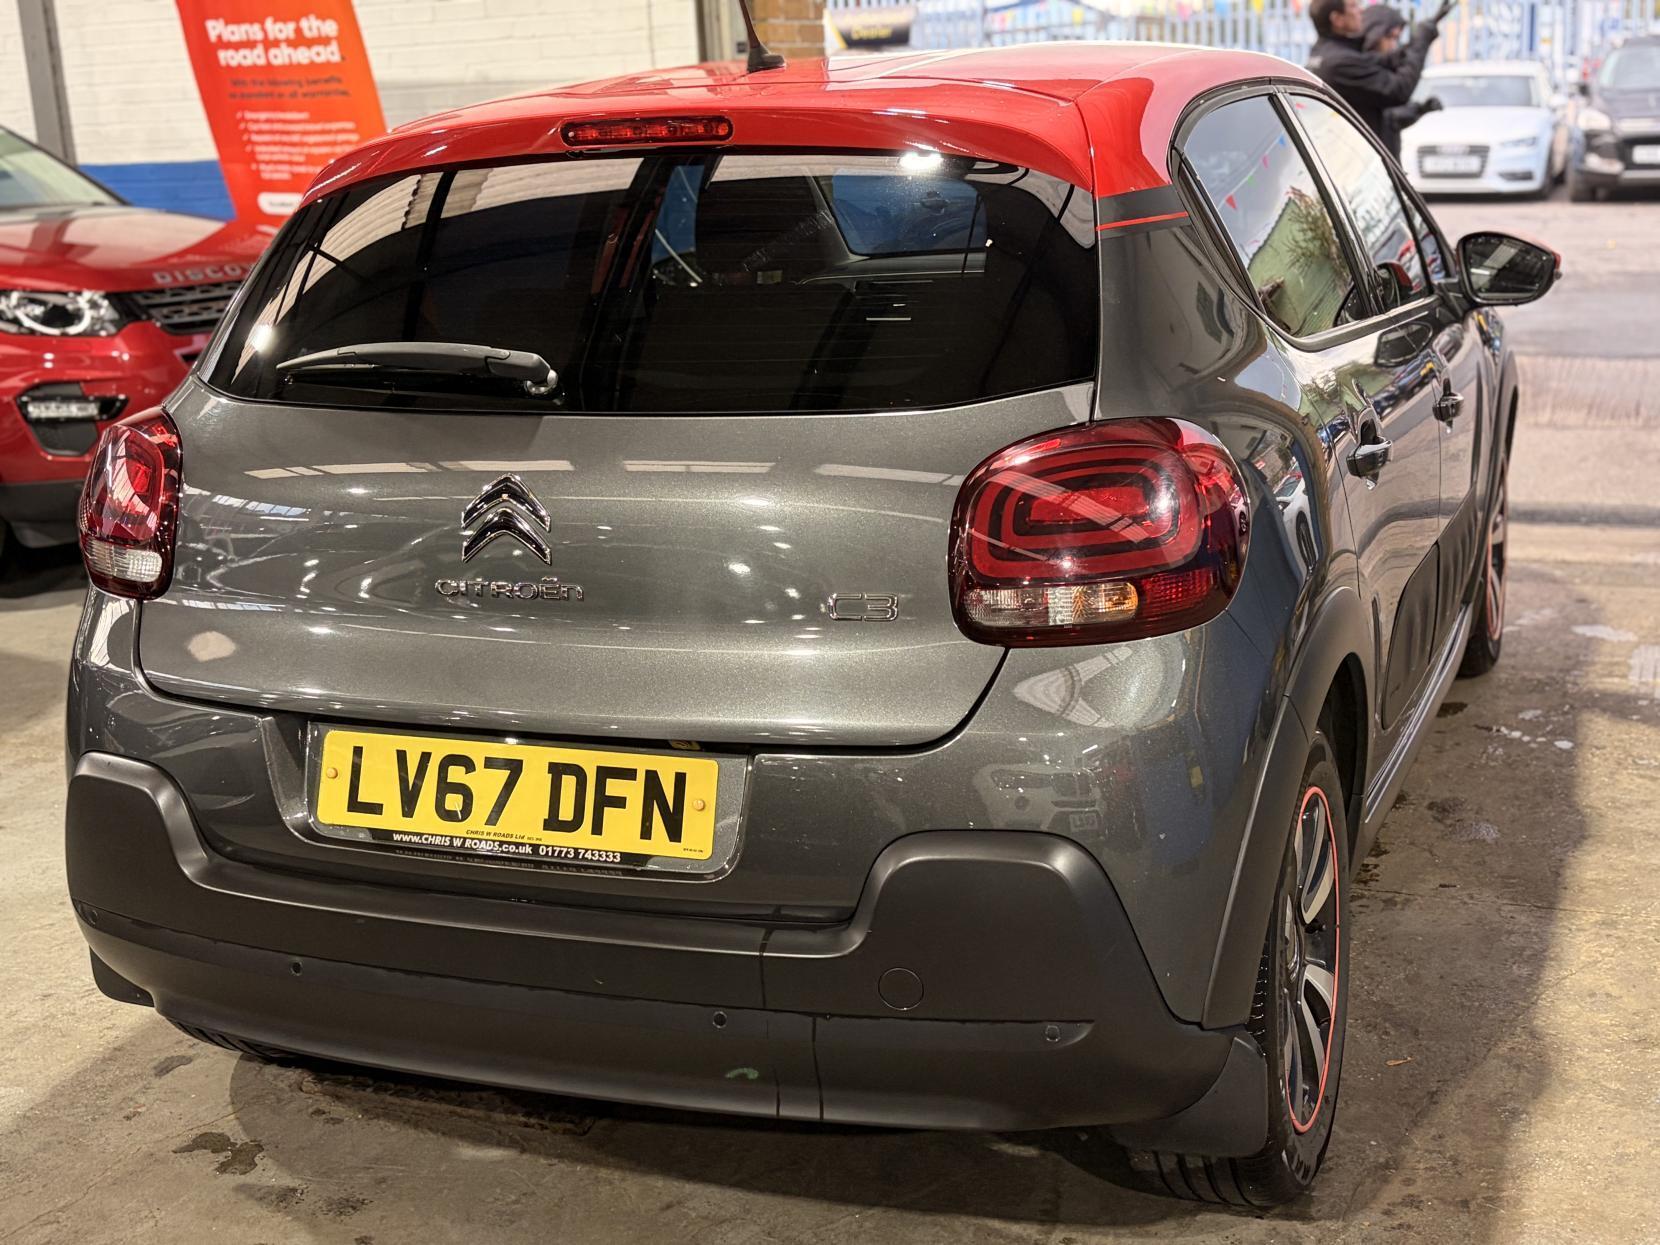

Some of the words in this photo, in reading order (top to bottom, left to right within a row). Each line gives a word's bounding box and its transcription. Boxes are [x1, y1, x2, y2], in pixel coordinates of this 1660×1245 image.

[205, 18, 265, 43] Plans
[264, 16, 297, 41] for
[299, 14, 339, 39] the
[217, 42, 268, 67] road
[823, 588, 867, 606] C3
[346, 746, 524, 827] LV67
[542, 762, 687, 844] DFN
[393, 833, 451, 847] www.CHRIS
[453, 838, 463, 847] W
[465, 839, 533, 854] ROADS.co.uk
[539, 845, 575, 858] 01773
[578, 849, 621, 863] 743333
